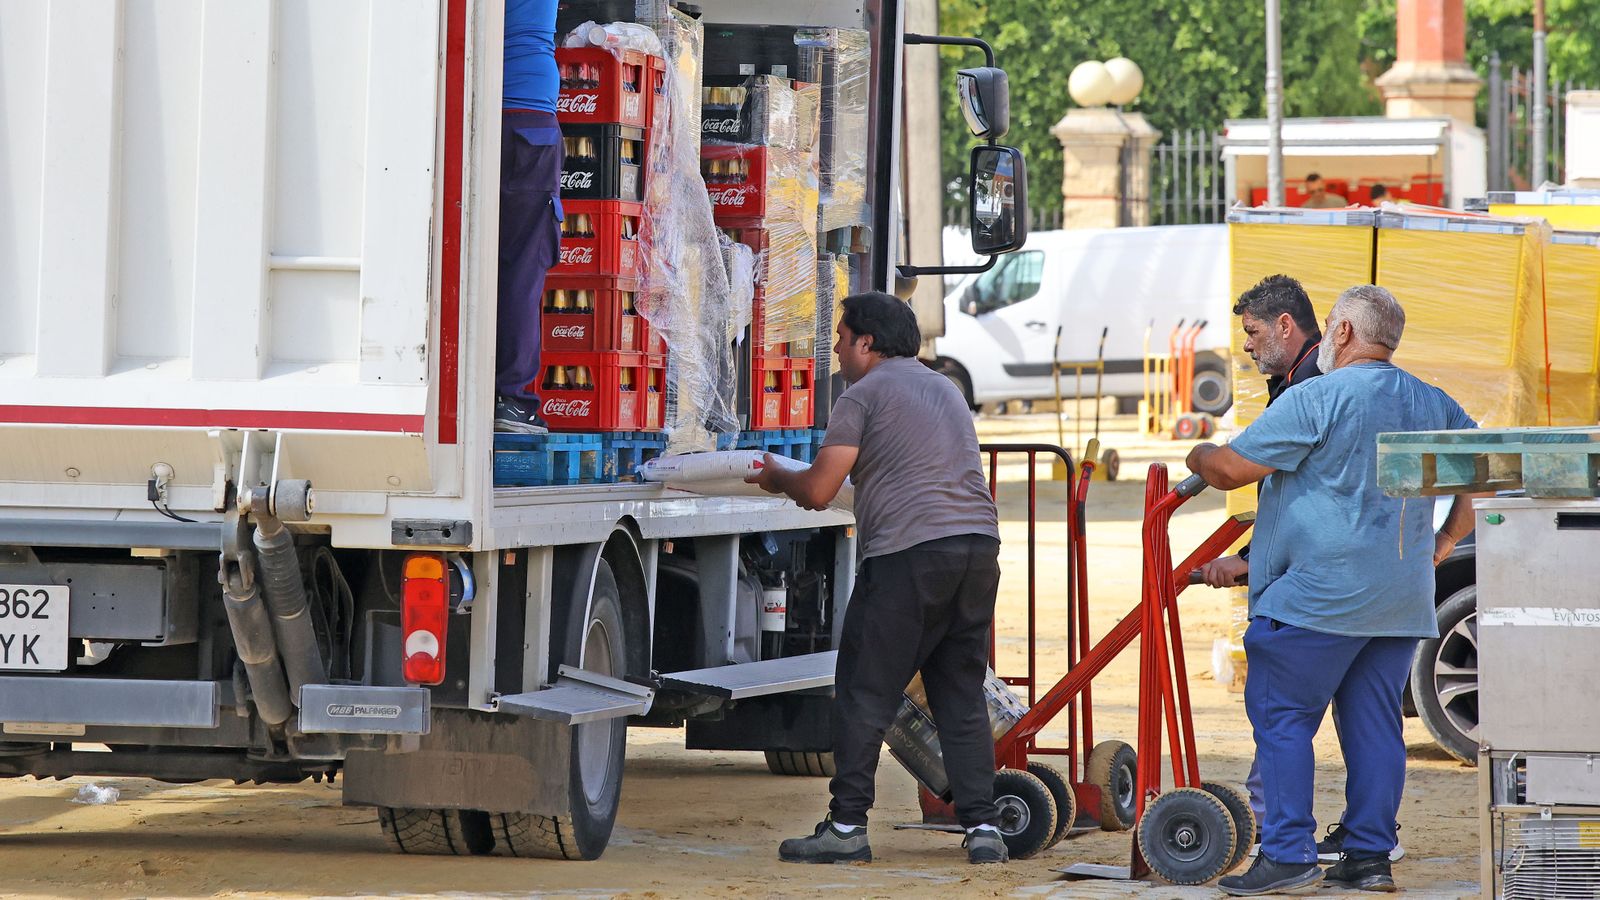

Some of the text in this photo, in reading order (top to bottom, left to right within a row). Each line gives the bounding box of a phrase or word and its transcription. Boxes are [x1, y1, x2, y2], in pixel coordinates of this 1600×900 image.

[557, 94, 598, 112] ca-Cola
[702, 119, 740, 133] Coca-Cola
[560, 171, 594, 189] a-Cola
[709, 188, 747, 206] ca-Cola
[560, 247, 593, 264] a-Cola
[552, 325, 585, 338] Coca-Cola
[543, 398, 591, 417] Coca-Cola
[354, 706, 398, 715] PALFINGER
